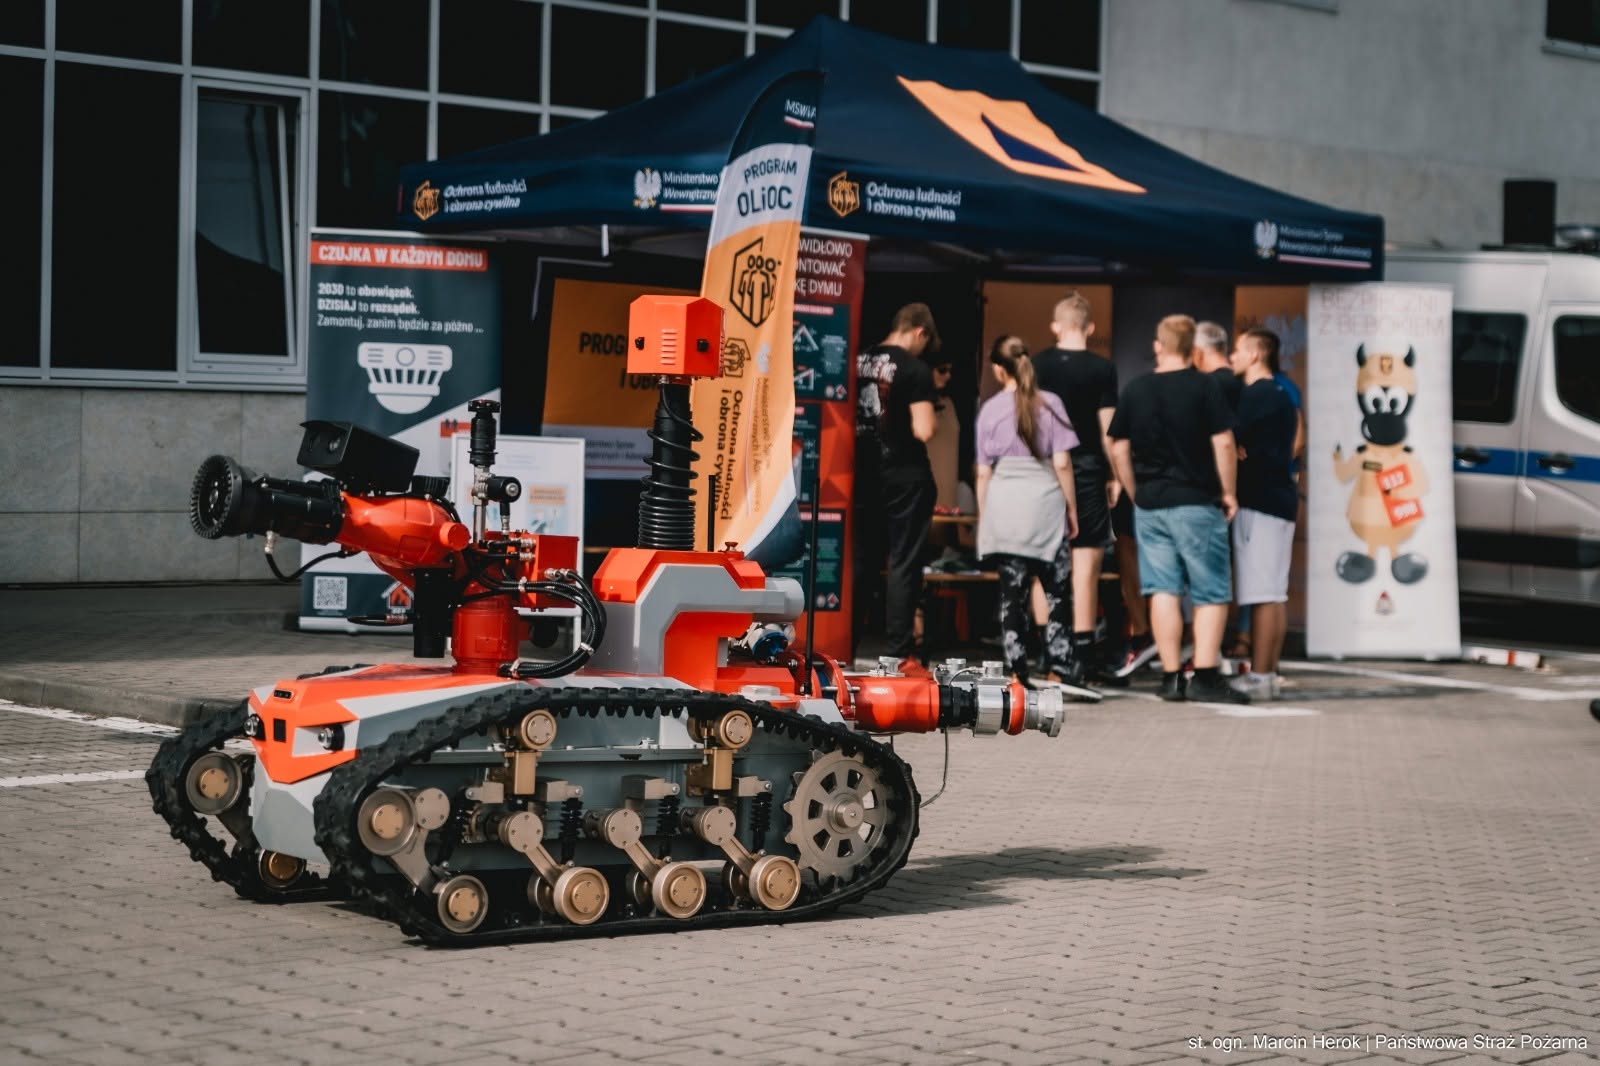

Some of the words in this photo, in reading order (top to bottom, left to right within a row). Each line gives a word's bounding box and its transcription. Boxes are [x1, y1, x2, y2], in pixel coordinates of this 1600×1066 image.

[662, 171, 718, 184] Ministerstwo
[744, 159, 797, 183] PROGRAM
[443, 184, 484, 198] Ochrona
[484, 179, 527, 194] ludności
[867, 181, 915, 201] Ochrona
[916, 187, 961, 206] ludności
[449, 199, 483, 212] obrona
[483, 195, 520, 211] cywilna
[738, 186, 792, 216] OLiOC
[873, 199, 913, 217] obrona
[914, 205, 956, 222] cywilna
[319, 245, 371, 262] CZUJKA
[374, 247, 388, 264] W
[389, 245, 444, 266] KAŻDYM
[446, 250, 483, 268] DOMU
[798, 238, 853, 258] WIDŁOWO
[317, 282, 345, 296] 2030
[345, 285, 357, 296] to
[357, 284, 415, 300] obowiązek.
[809, 278, 843, 297] DYMU
[317, 297, 357, 312] DZISIAJ
[358, 302, 369, 313] to
[370, 302, 420, 316] rozsądek.
[317, 313, 365, 331] Zamontuj,
[366, 317, 397, 329] zanim
[397, 318, 430, 332] będzie
[431, 320, 443, 331] za
[443, 320, 474, 334] późno
[579, 331, 628, 356] PROG
[717, 396, 731, 450] obrona
[729, 390, 744, 455] Ochrona
[720, 458, 737, 520] ludności
